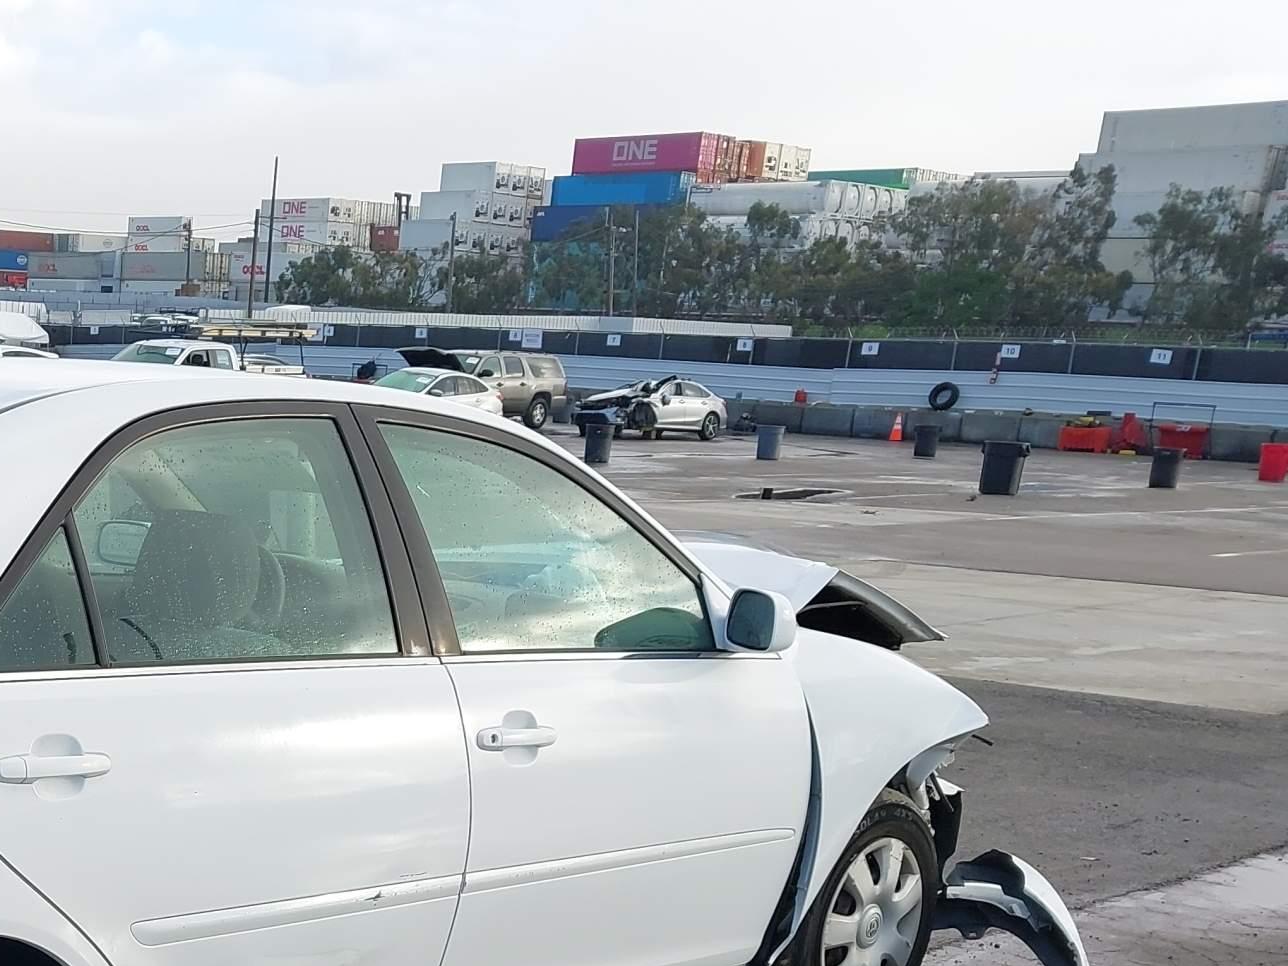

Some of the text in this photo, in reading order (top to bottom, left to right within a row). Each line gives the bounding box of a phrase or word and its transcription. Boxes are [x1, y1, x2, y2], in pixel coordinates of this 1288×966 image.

[613, 139, 658, 161] ONE
[282, 201, 307, 215] ONE
[280, 224, 305, 238] ONE
